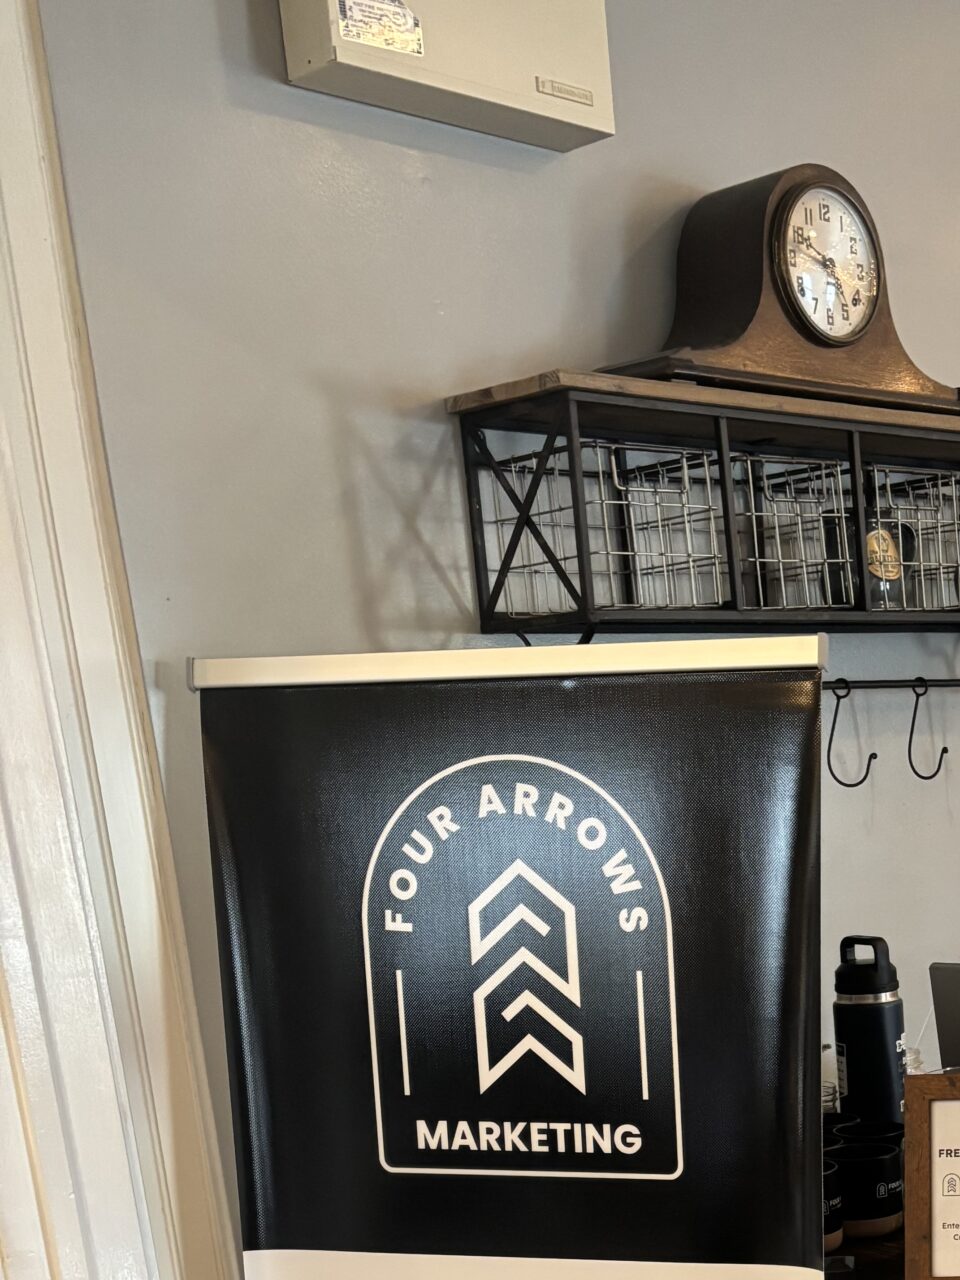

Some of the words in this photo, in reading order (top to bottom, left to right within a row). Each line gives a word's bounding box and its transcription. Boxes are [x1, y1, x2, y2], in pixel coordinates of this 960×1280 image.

[804, 207, 813, 226] 11
[818, 202, 830, 223] 12
[839, 215, 844, 233] 1
[812, 296, 819, 315] 7
[841, 302, 850, 321] 5
[826, 308, 835, 326] 6
[385, 805, 460, 932] FOUR
[478, 782, 649, 933] ARROWS
[415, 1119, 642, 1155] MARKETING
